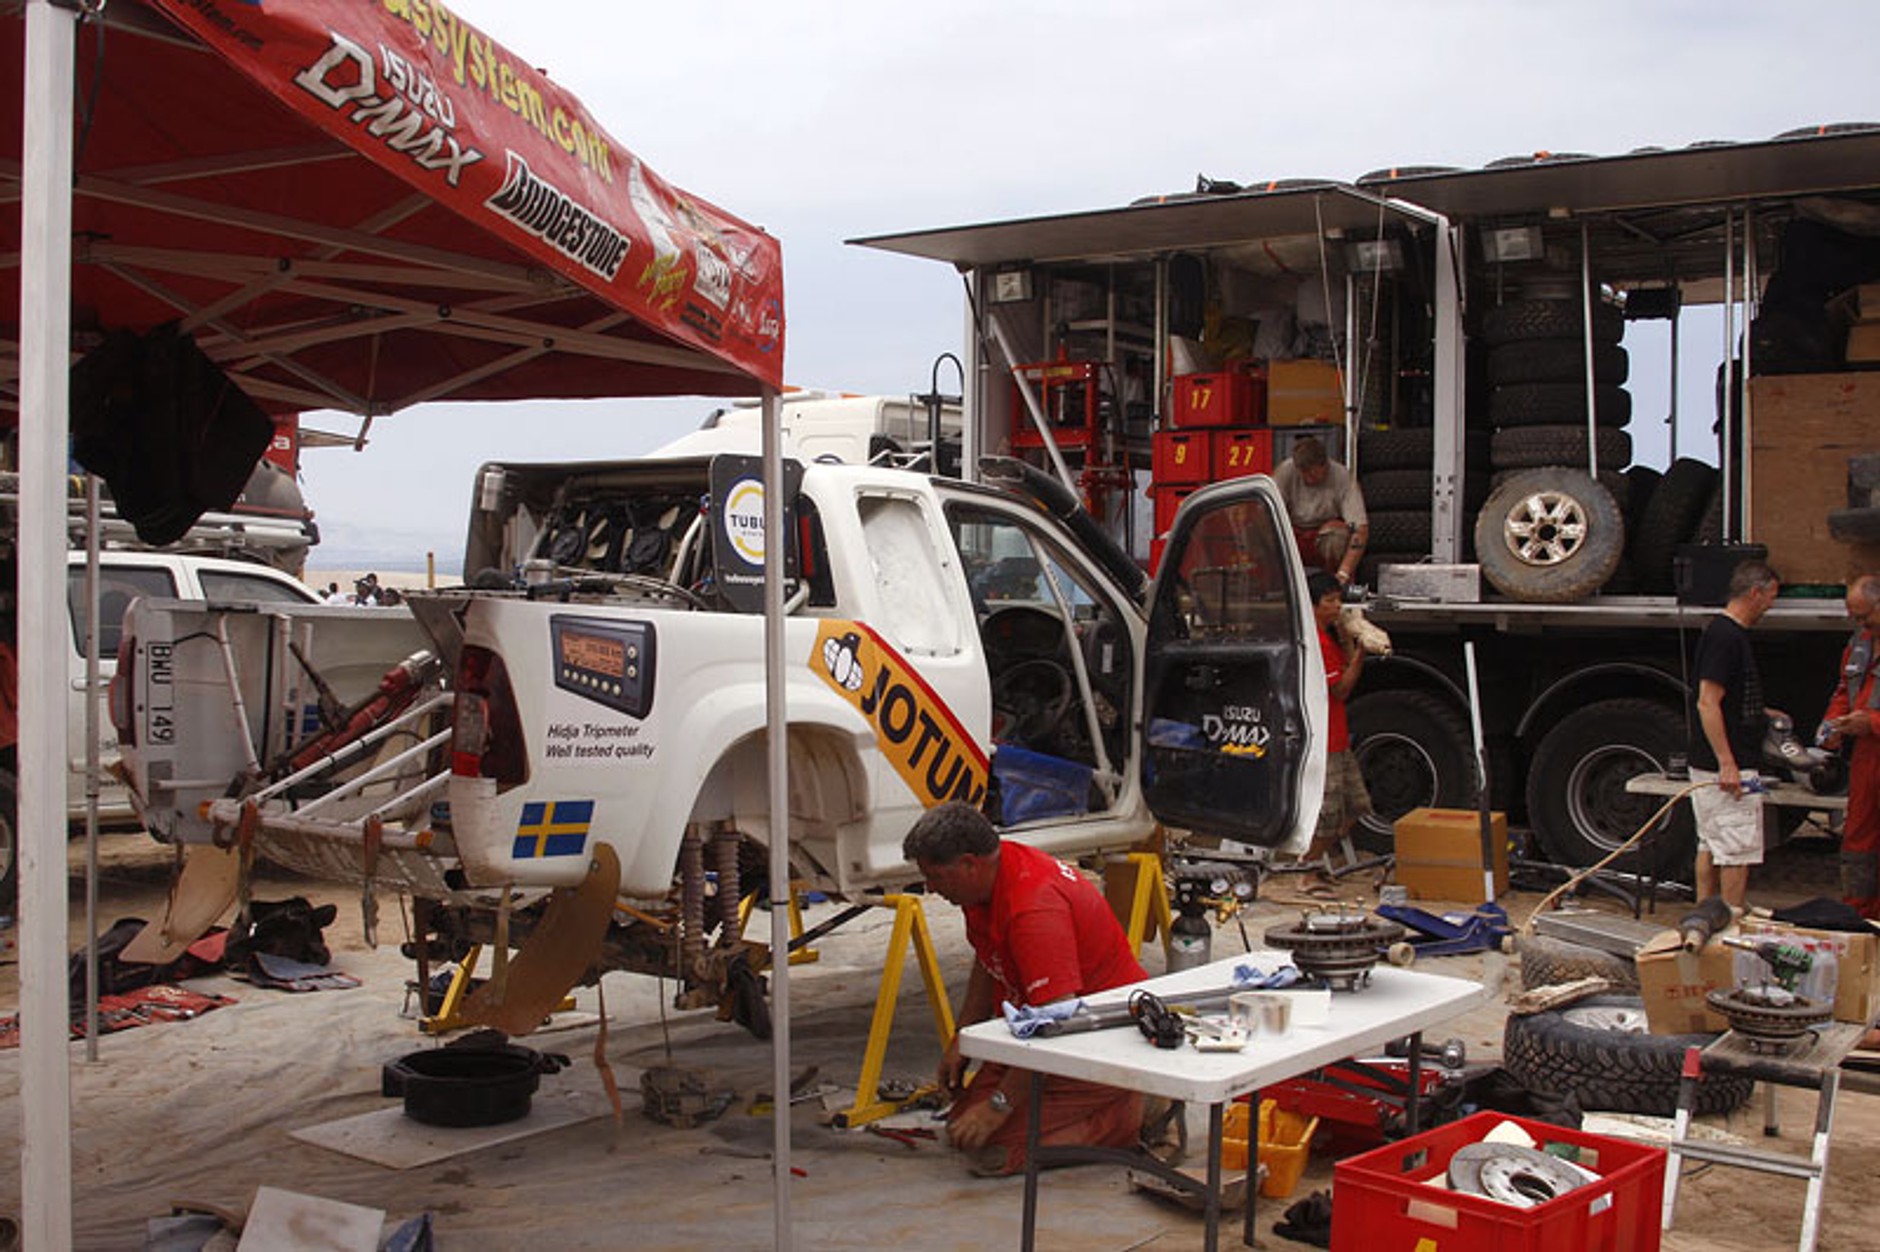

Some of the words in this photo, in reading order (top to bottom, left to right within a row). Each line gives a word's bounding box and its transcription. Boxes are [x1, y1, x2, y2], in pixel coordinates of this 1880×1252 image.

[374, 42, 455, 129] ISUZU
[487, 150, 630, 281] BRIDGESTONE
[1191, 389, 1211, 411] 17
[1174, 444, 1187, 465] 9
[150, 705, 174, 741] 149
[1223, 705, 1261, 723] ISUZU
[546, 724, 580, 741] Hidja
[583, 723, 640, 740] Tripmeter
[861, 665, 985, 803] JOTUN
[545, 744, 573, 758] Well
[574, 744, 614, 758] tested
[614, 742, 656, 760] quality
